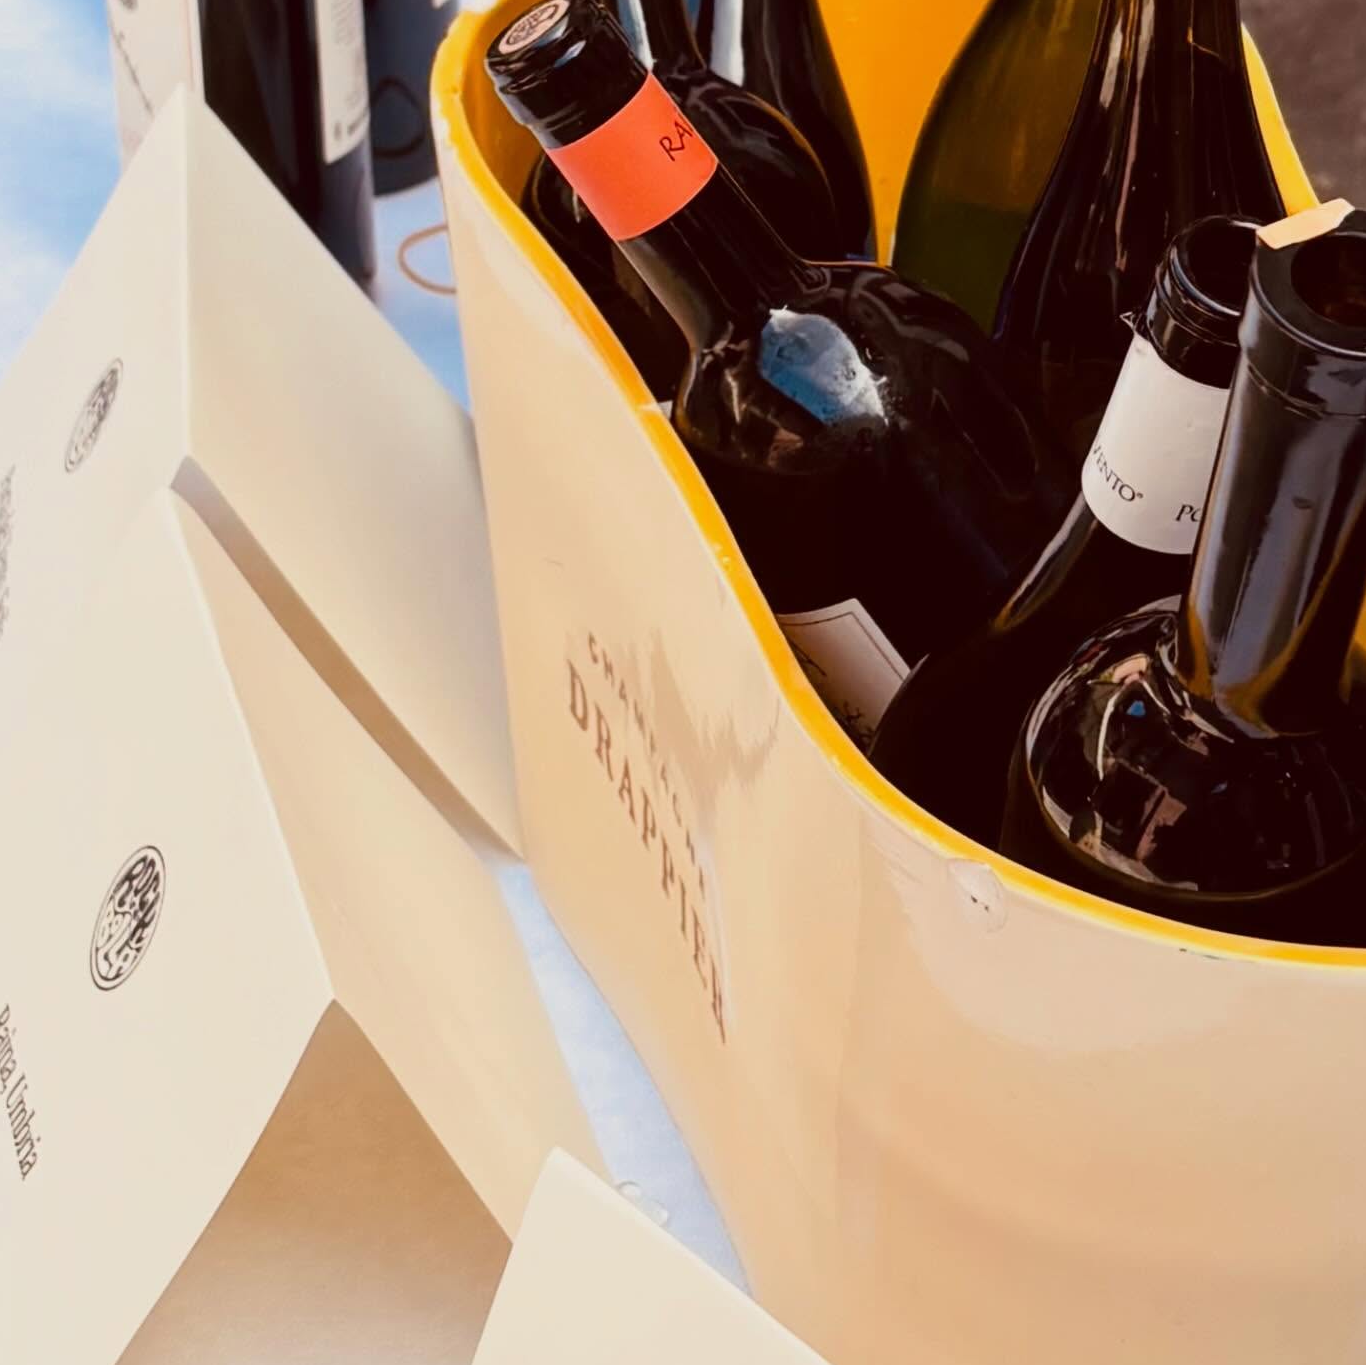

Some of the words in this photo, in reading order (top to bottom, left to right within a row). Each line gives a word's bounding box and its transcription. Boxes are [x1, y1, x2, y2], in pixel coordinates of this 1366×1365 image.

[659, 112, 694, 162] RA
[566, 659, 726, 1045] DRAPPIER
[6, 1072, 41, 1181] Umbria
